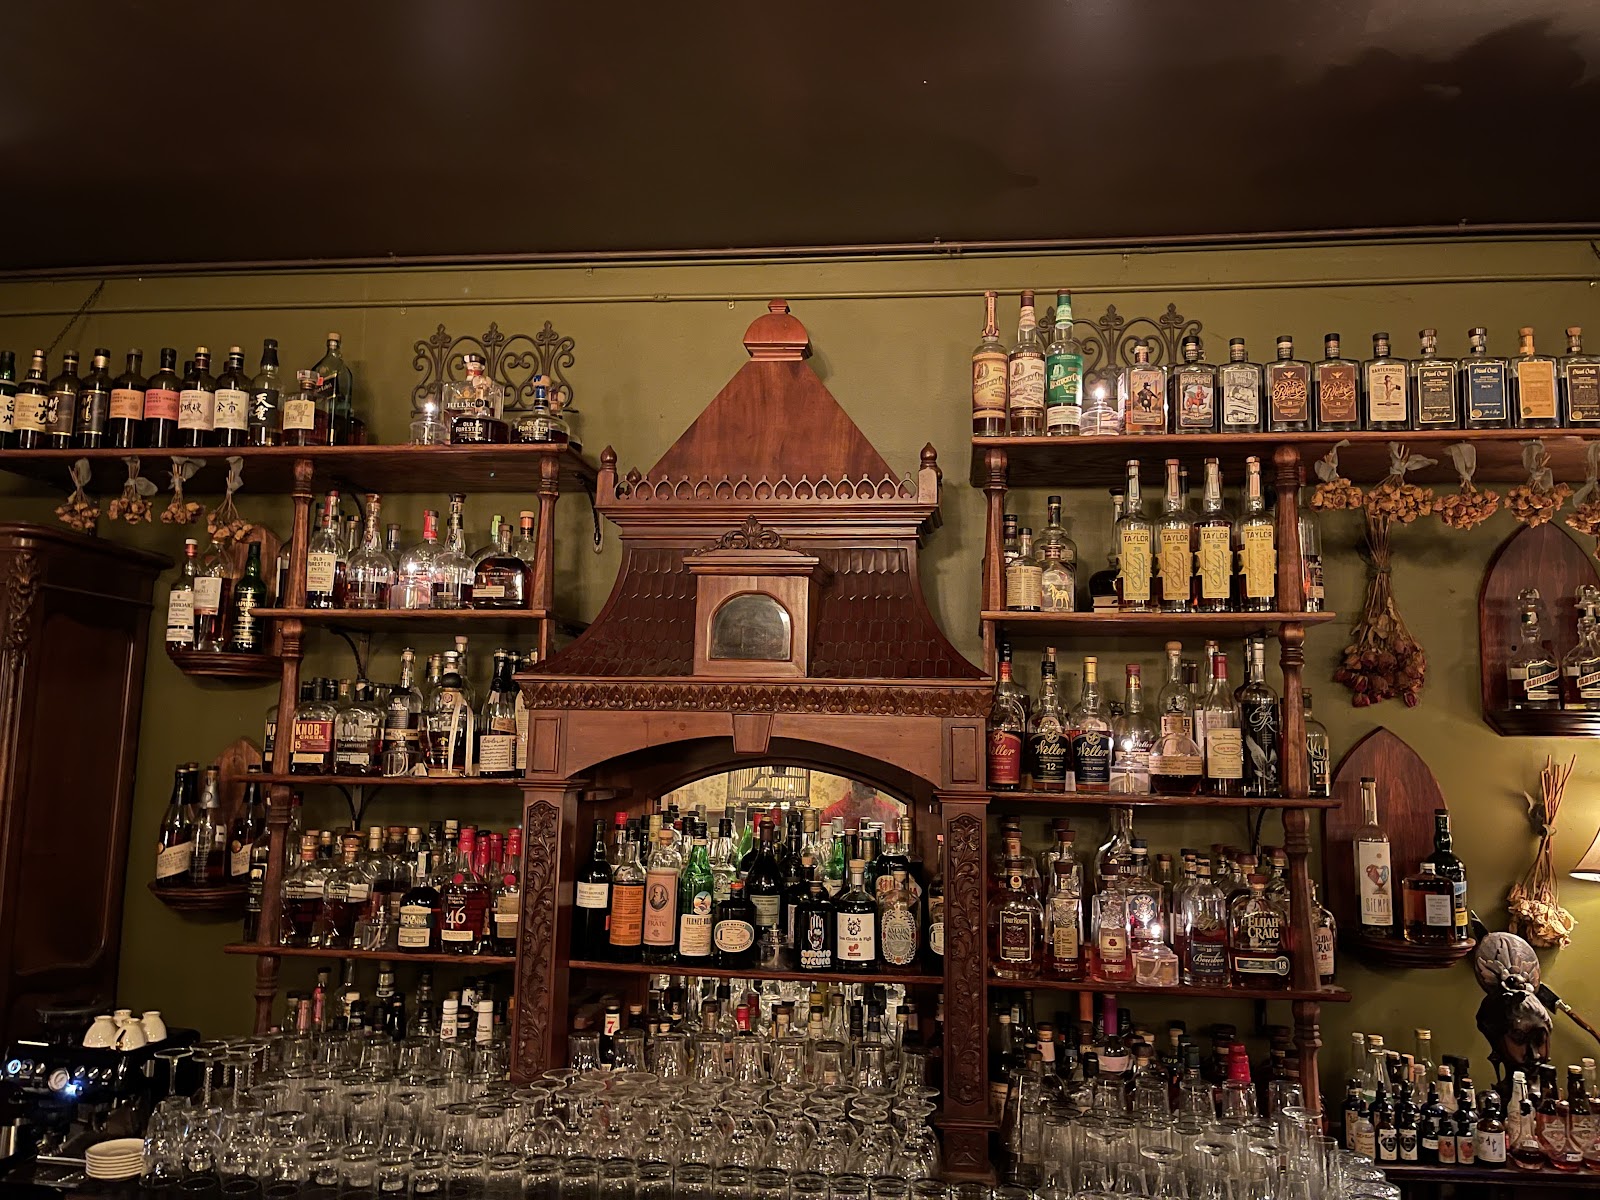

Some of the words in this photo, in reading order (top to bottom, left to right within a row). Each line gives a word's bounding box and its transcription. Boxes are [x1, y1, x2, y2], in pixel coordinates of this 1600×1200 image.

[1124, 535, 1149, 543] TAYLOR
[1163, 534, 1189, 542] TAYLOR
[1203, 532, 1229, 540] TAYLOR
[1246, 531, 1273, 539] TAYLOR
[295, 723, 321, 736] KNOB
[294, 740, 301, 749] 15
[1034, 739, 1066, 756] Weller
[1076, 741, 1109, 757] Weller
[1046, 762, 1056, 771] 12
[446, 905, 467, 929] 46
[1248, 916, 1279, 929] ELIJAH
[1247, 927, 1279, 940] CRAIG
[1278, 961, 1287, 970] 18
[606, 1020, 616, 1034] 7
